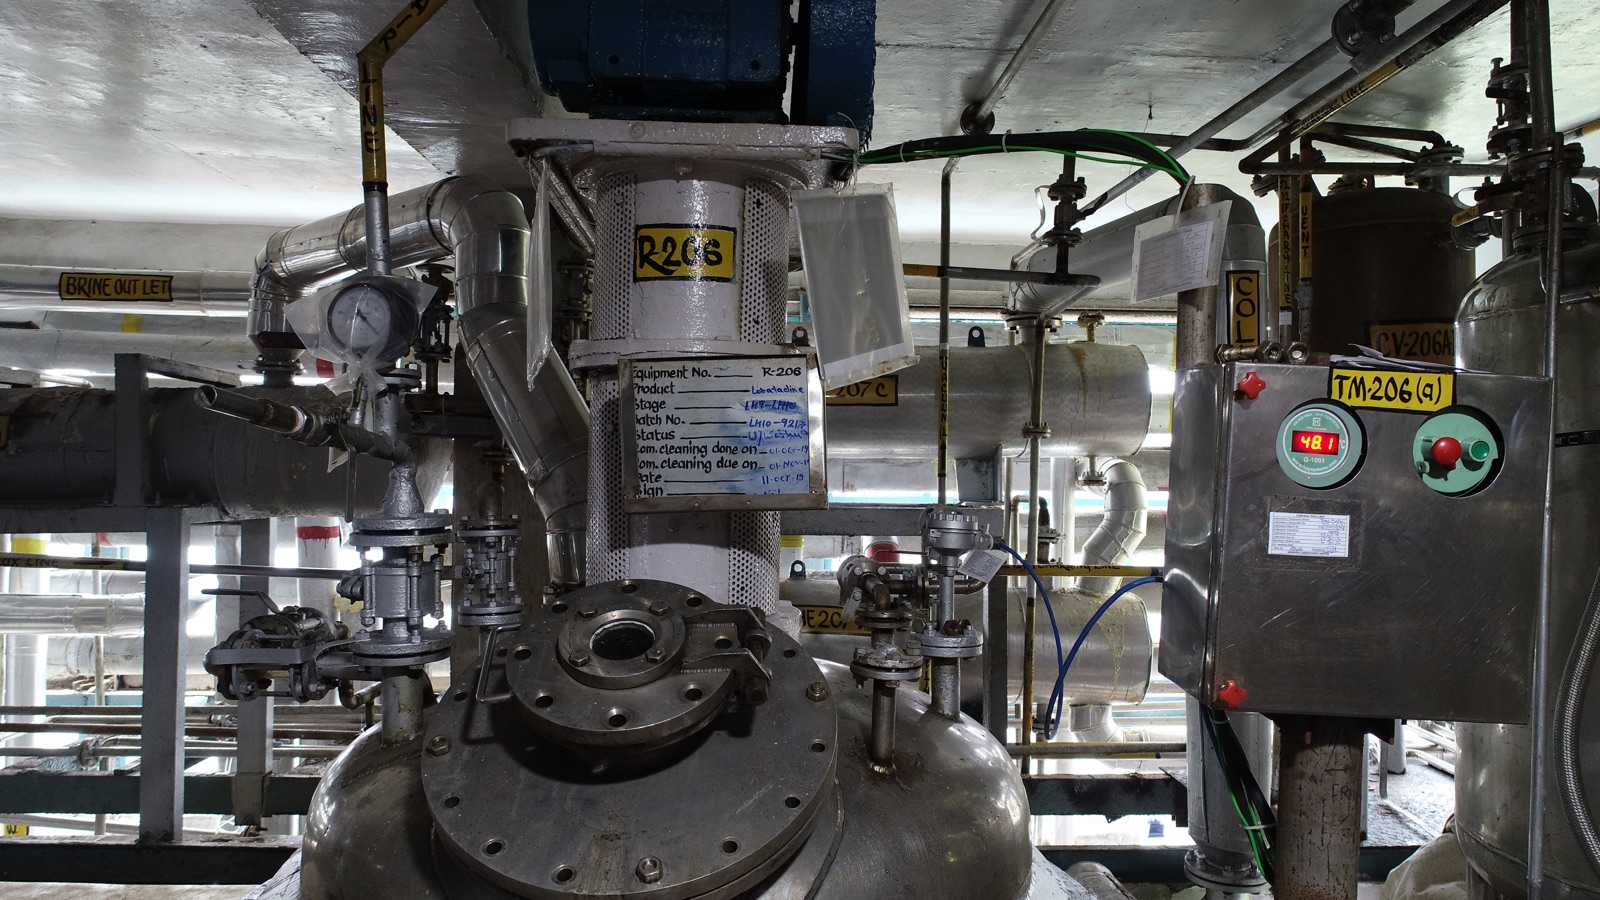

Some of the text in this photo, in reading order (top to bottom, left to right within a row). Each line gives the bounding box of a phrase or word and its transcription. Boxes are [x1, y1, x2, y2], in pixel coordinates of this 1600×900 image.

[361, 62, 381, 154] LINE
[65, 276, 111, 298] BRINE
[691, 366, 712, 378] No.
[762, 367, 802, 378] R-206
[875, 382, 889, 398] C
[665, 413, 686, 426] No.
[638, 440, 758, 458] om. cleaning done on
[1300, 435, 1334, 451] 48.1
[638, 456, 758, 473] om. cleaning due on
